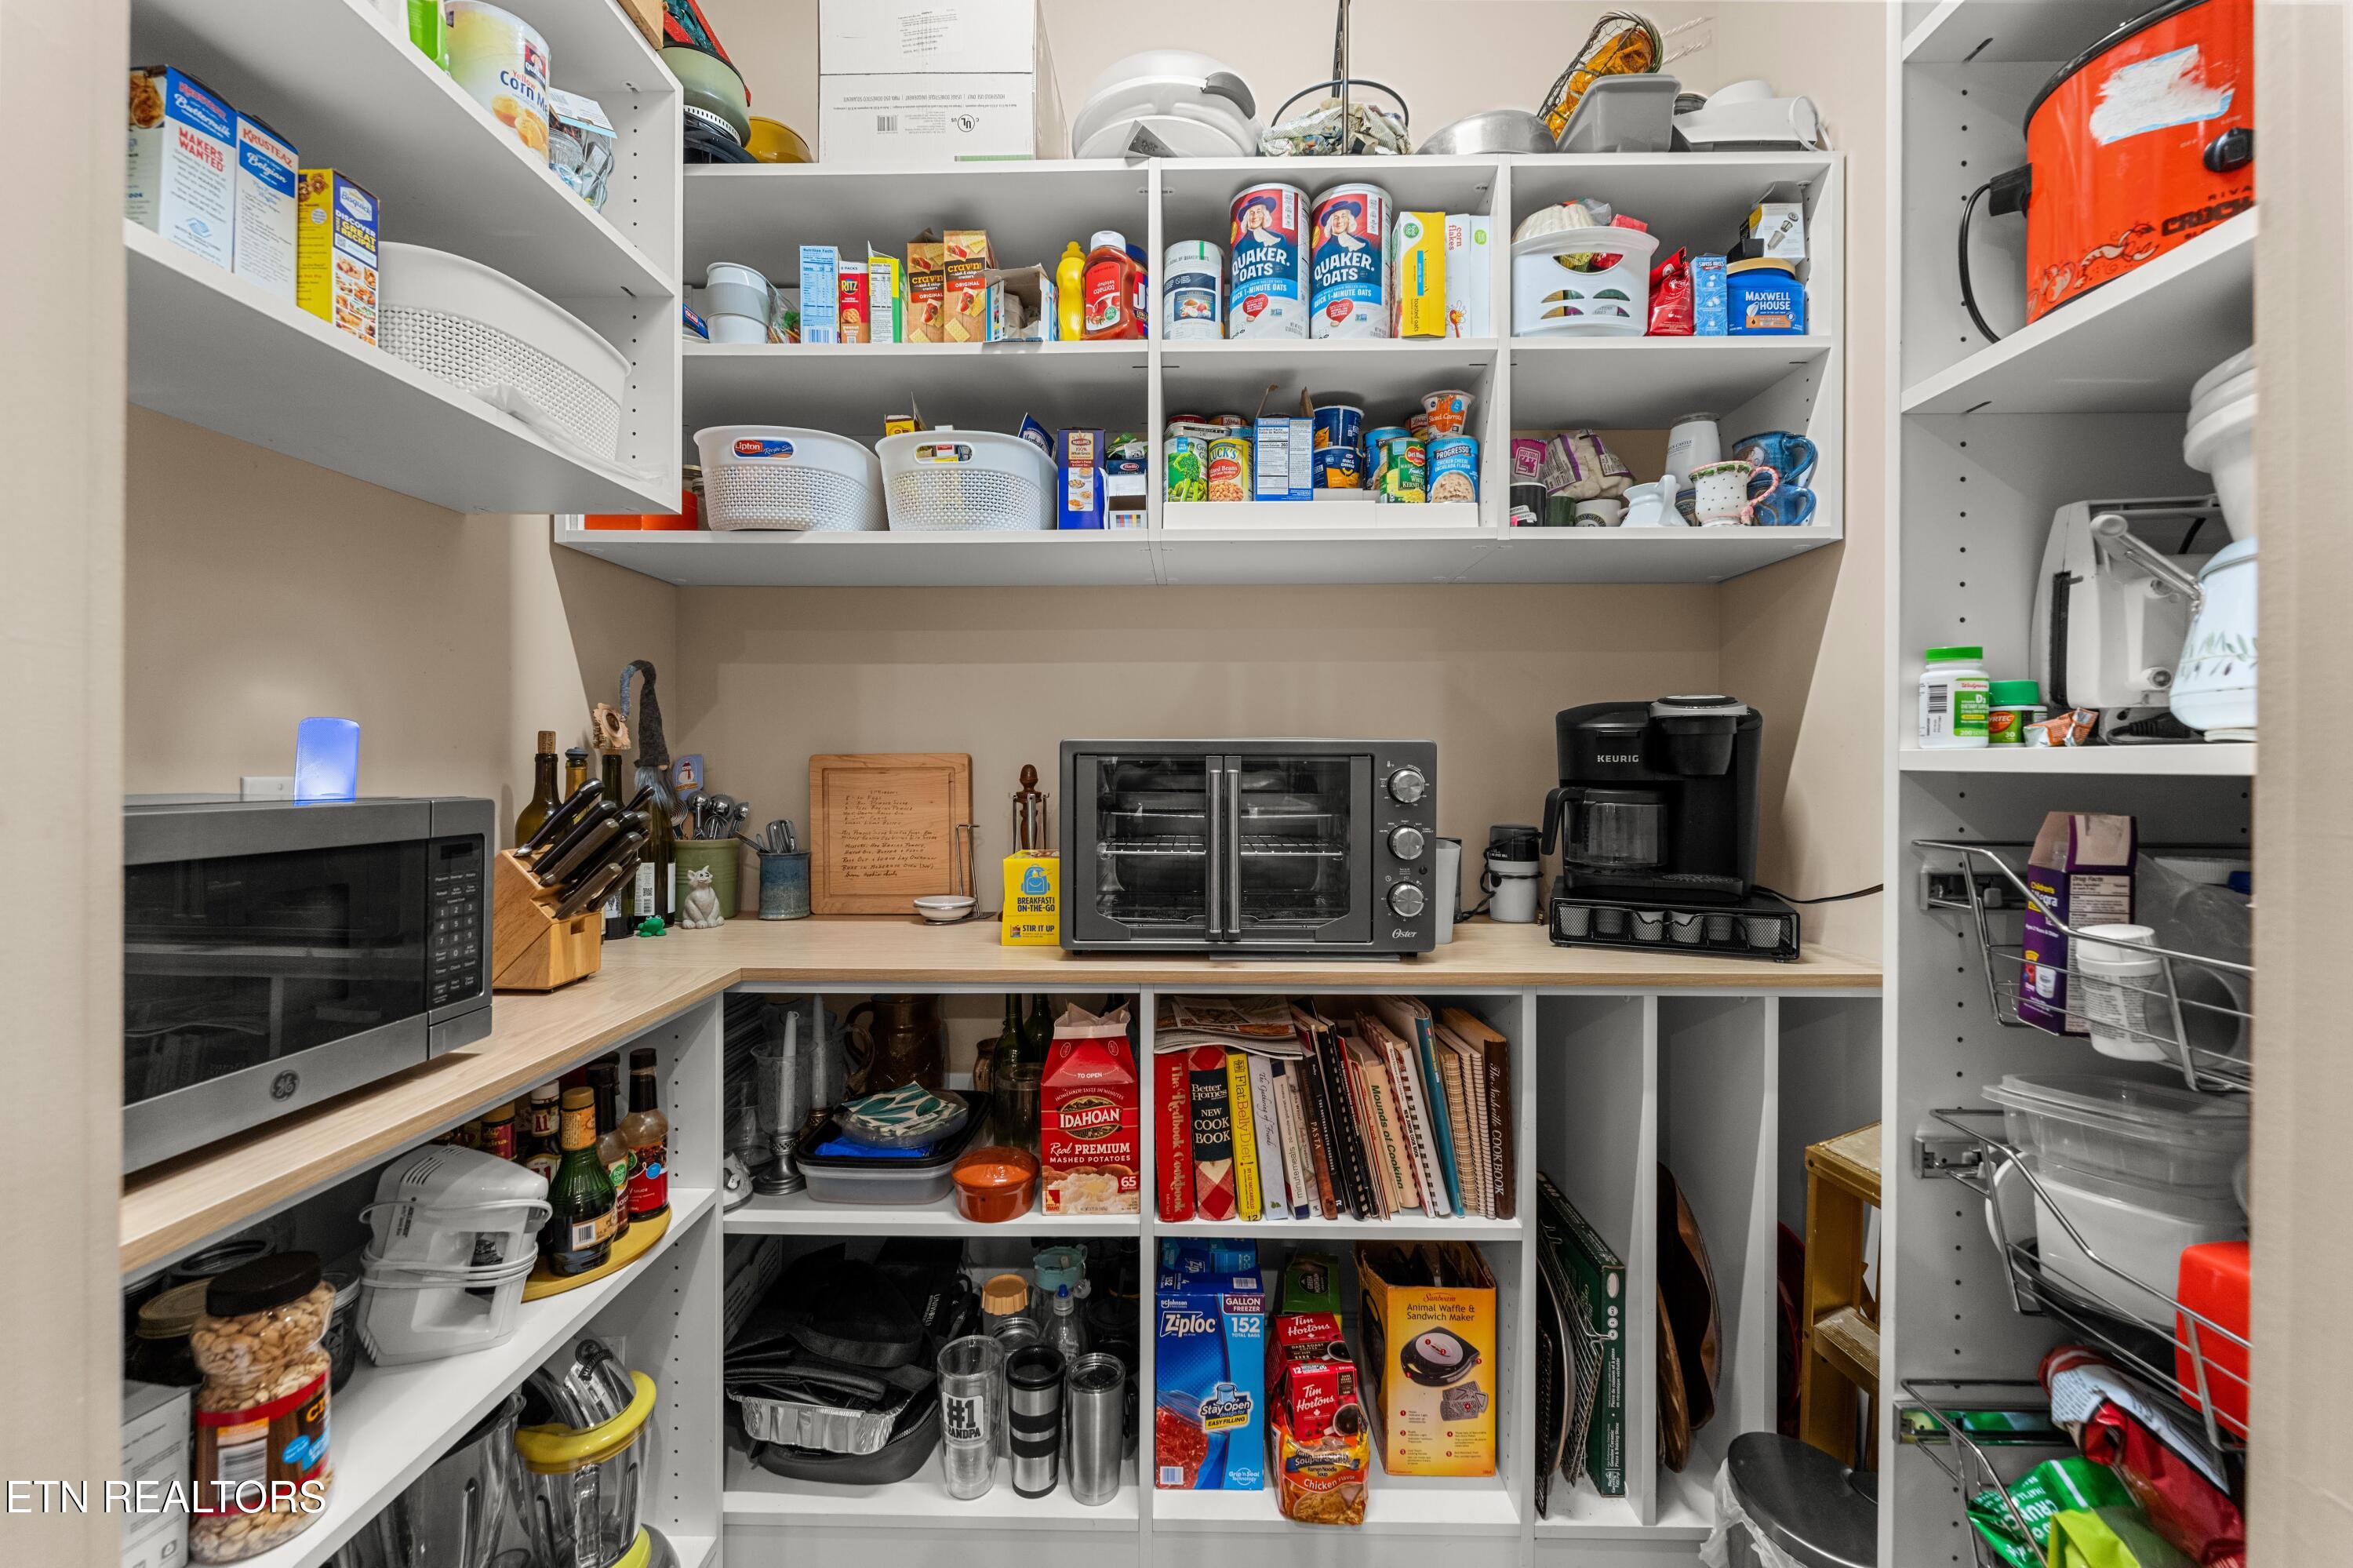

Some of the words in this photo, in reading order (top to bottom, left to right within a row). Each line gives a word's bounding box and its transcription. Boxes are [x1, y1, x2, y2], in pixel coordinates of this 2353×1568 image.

[500, 70, 534, 101] Corn
[512, 70, 536, 89] Yellow
[174, 93, 231, 138] Buttermilk
[179, 126, 224, 162] MAKERS
[242, 128, 292, 168] KRUSTEAZ
[179, 137, 224, 172] WANTED
[247, 152, 287, 183] Belgian
[2208, 185, 2253, 202] RIVA
[341, 191, 371, 214] Bisquick
[335, 209, 376, 238] DISCOVER
[341, 227, 376, 252] RECIPES
[342, 220, 376, 245] GREAT
[947, 263, 980, 273] crav'n
[1239, 262, 1274, 282] OATS
[841, 280, 858, 291] RITZ
[1322, 267, 1358, 287] OATS
[1093, 285, 1115, 295] tomato
[1244, 284, 1271, 296] 1-MINUTE
[1314, 296, 1326, 308] QUICK
[1328, 289, 1356, 300] 1-MINUTE
[1745, 291, 1791, 301] MAXWELL
[1759, 301, 1791, 311] HOUSE
[1443, 413, 1462, 421] Carrots
[1436, 446, 1470, 459] PROGRESSO
[1597, 755, 1639, 763] KEURIG
[1392, 928, 1417, 940] Oster
[1169, 1063, 1183, 1089] The
[1259, 1072, 1267, 1083] The
[1489, 1062, 1500, 1082] The
[1055, 1088, 1082, 1101] HOMEMADE
[1104, 1089, 1125, 1101] MINUTES
[1191, 1083, 1222, 1093] Better
[1191, 1089, 1227, 1101] Homes
[1235, 1075, 1246, 1101] Flat
[1257, 1085, 1271, 1113] Gathering
[1489, 1081, 1501, 1128] Nashville
[1060, 1108, 1120, 1128] IDAHOAN
[1167, 1089, 1186, 1150] Redbook
[1201, 1108, 1222, 1117] NEW
[1235, 1101, 1249, 1133] Belly
[1371, 1084, 1388, 1128] Mounds
[1383, 1130, 1392, 1141] of
[1194, 1116, 1230, 1130] COOK
[1195, 1131, 1231, 1144] BOOK
[1265, 1124, 1277, 1148] Friends
[1311, 1122, 1321, 1149] PASTA
[1049, 1142, 1073, 1157] Real
[1075, 1142, 1130, 1155] PREMIUM
[1326, 1147, 1335, 1172] COOKBOOK
[1492, 1130, 1504, 1196] COOKBOOK
[1289, 1147, 1303, 1199] minutemeals
[1120, 1176, 1137, 1188] 65
[1170, 1151, 1188, 1213] Cookbook
[1164, 1276, 1173, 1286] 152
[1423, 1293, 1457, 1302] Sunbeam
[1406, 1303, 1436, 1312] Animal
[1438, 1304, 1467, 1313] Waffle
[1469, 1304, 1475, 1313] &
[1165, 1314, 1216, 1337] Ziploc
[1231, 1317, 1260, 1333] 152
[1291, 1315, 1314, 1326] Tim
[1406, 1312, 1447, 1321] Sandwich
[1449, 1313, 1475, 1322] Maker
[1287, 1323, 1331, 1337] Hortons
[1302, 1384, 1322, 1398] Tim
[1201, 1402, 1224, 1415] Stay
[1224, 1400, 1251, 1413] Open
[1297, 1395, 1334, 1412] Hortons
[946, 1397, 977, 1428] #1
[1223, 1416, 1246, 1424] FILLING
[1304, 1478, 1337, 1490] Chicken
